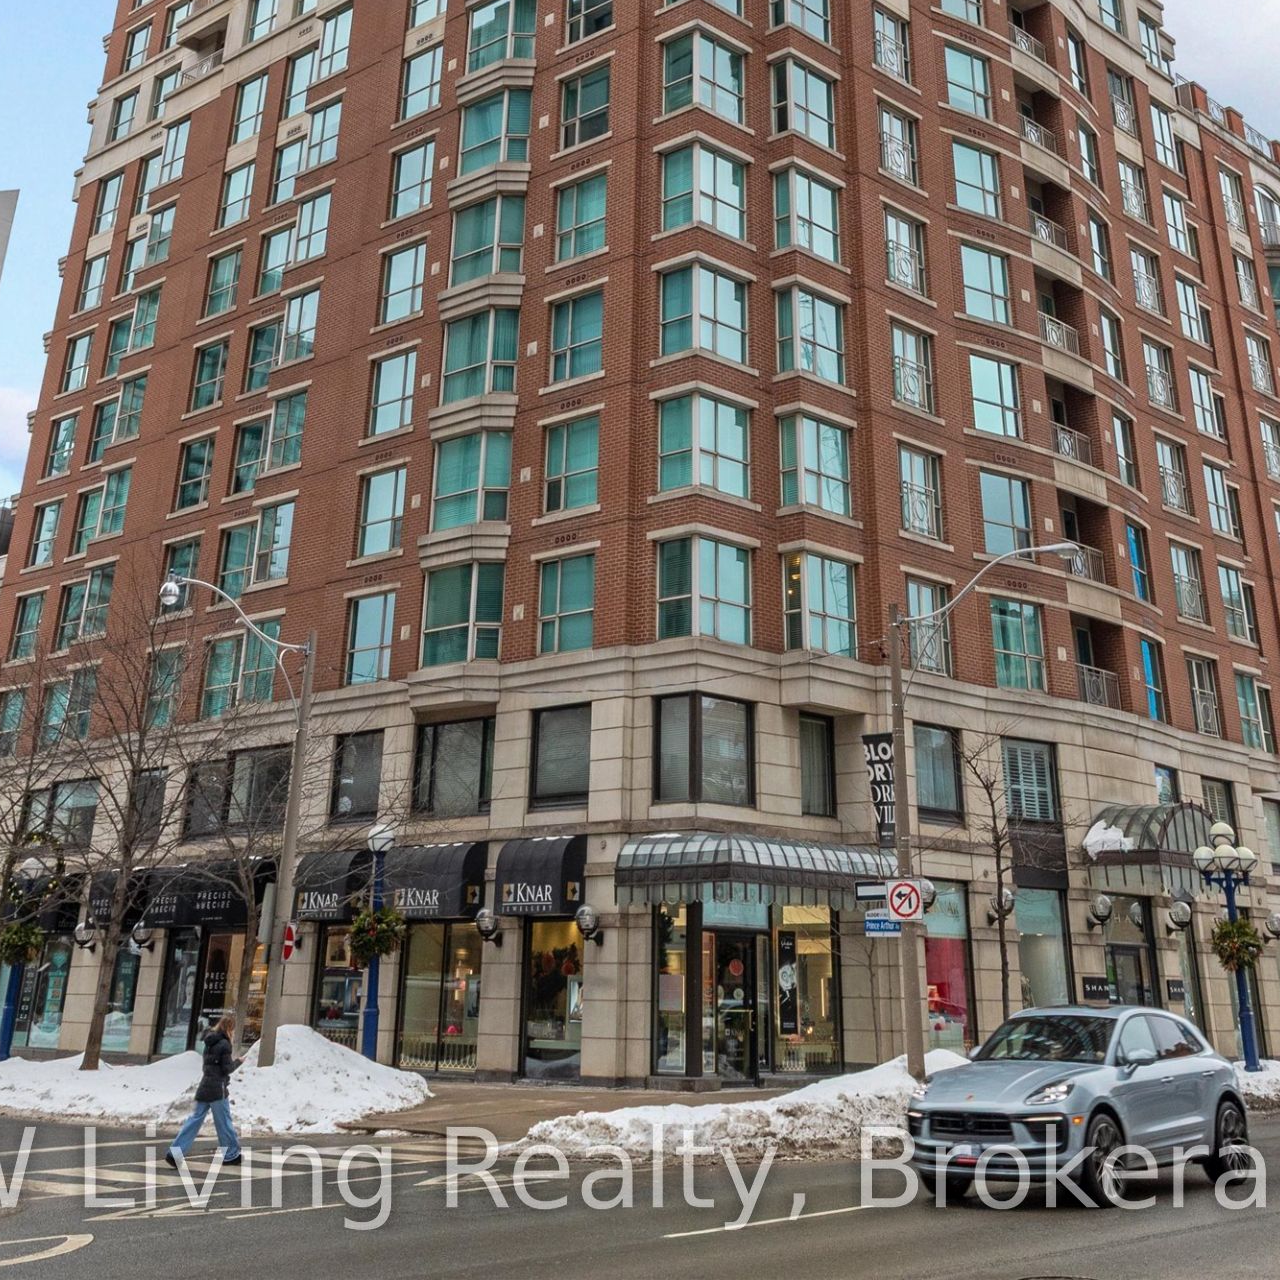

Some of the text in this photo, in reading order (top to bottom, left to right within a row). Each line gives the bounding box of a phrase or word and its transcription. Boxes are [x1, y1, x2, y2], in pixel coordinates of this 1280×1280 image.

[151, 896, 177, 904] PRECIS
[309, 891, 339, 909] KNAR
[407, 887, 440, 906] KNAR
[517, 883, 552, 902] KNAR
[866, 921, 880, 930] Prince
[880, 921, 895, 930] Arthur
